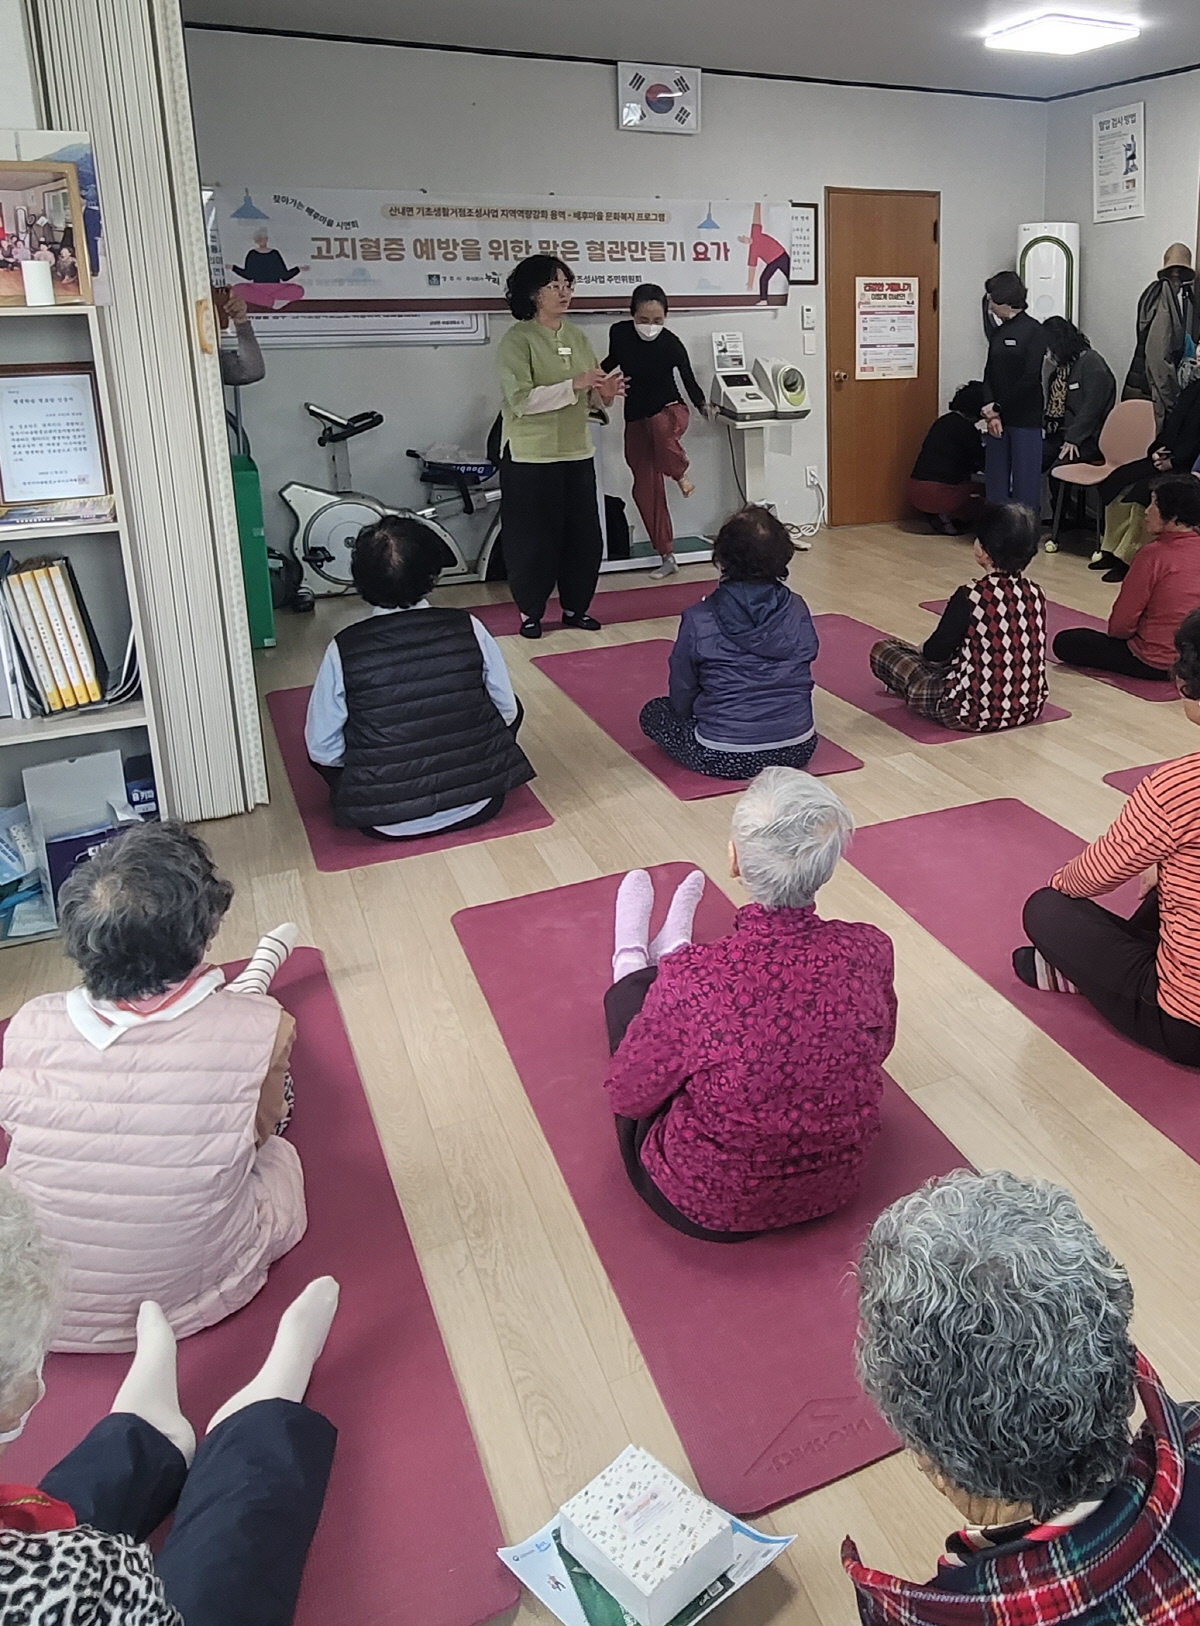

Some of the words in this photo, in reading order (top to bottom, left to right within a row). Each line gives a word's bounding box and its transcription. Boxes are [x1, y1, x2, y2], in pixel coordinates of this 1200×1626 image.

[388, 206, 414, 217] 산내면
[416, 206, 499, 218] 기초생활거점조성사업
[500, 208, 548, 220] 지역역량강화
[550, 209, 566, 221] 용역
[573, 211, 604, 221] 배후마을
[605, 211, 635, 222] 문화복지
[636, 212, 666, 222] 프로그램
[310, 236, 406, 261] 고지혈증
[412, 237, 482, 262] 예방을
[488, 238, 532, 262] 위한
[585, 239, 686, 262] 혈관만들기
[692, 241, 731, 262] 요가
[606, 274, 643, 285] 주민위원회
